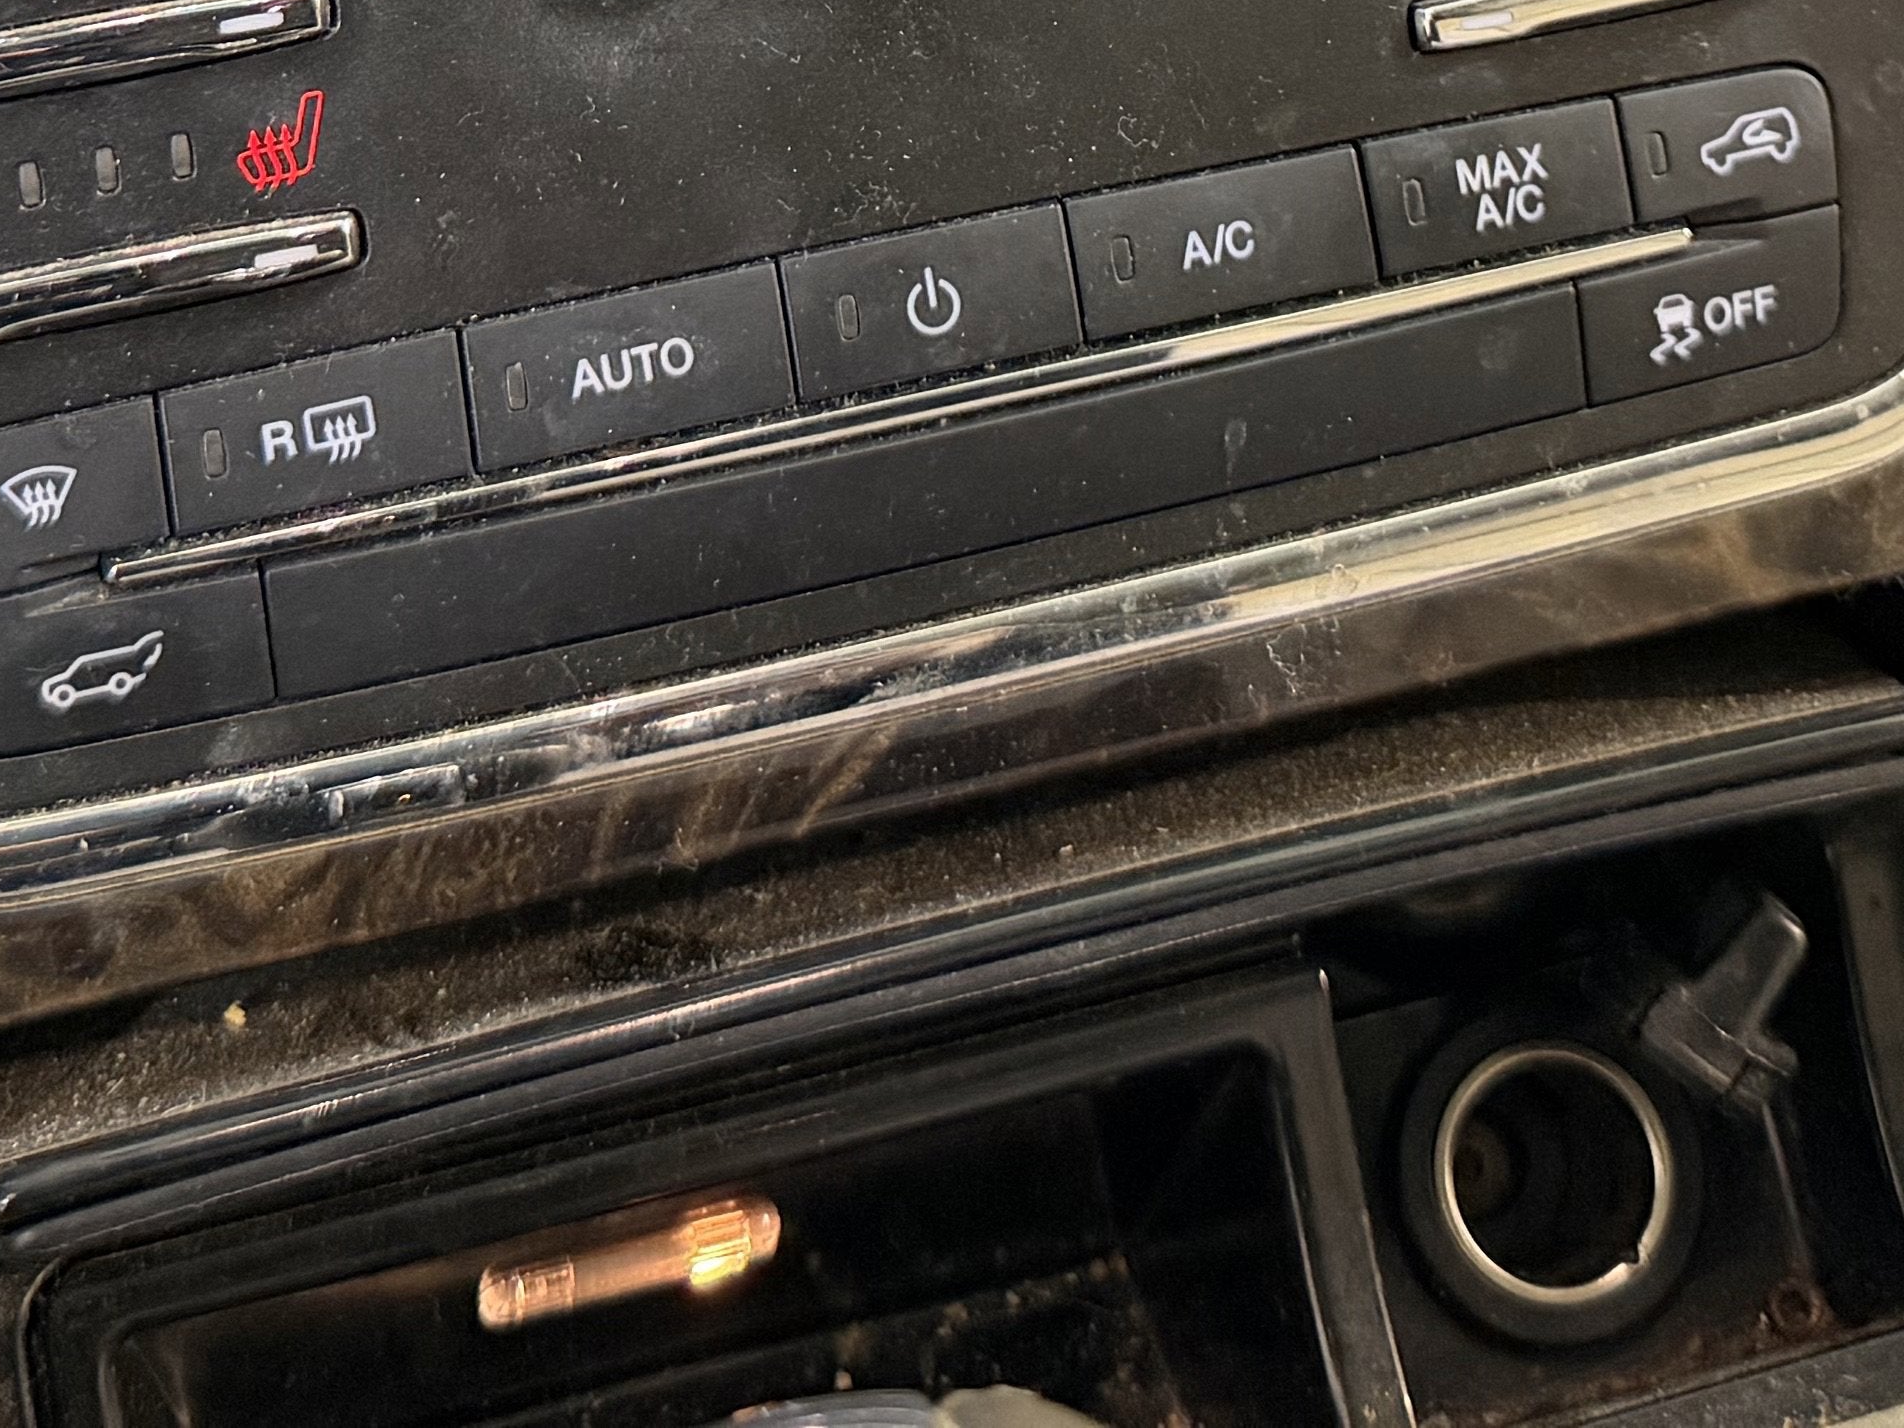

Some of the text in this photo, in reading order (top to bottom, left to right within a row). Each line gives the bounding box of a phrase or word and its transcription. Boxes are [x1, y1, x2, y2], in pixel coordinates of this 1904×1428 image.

[1456, 143, 1549, 194] MAX
[1475, 185, 1546, 231] A/C
[1182, 220, 1256, 271] A/C
[1704, 285, 1778, 335] OFF
[570, 337, 694, 401] AUTO
[260, 419, 298, 458] R
